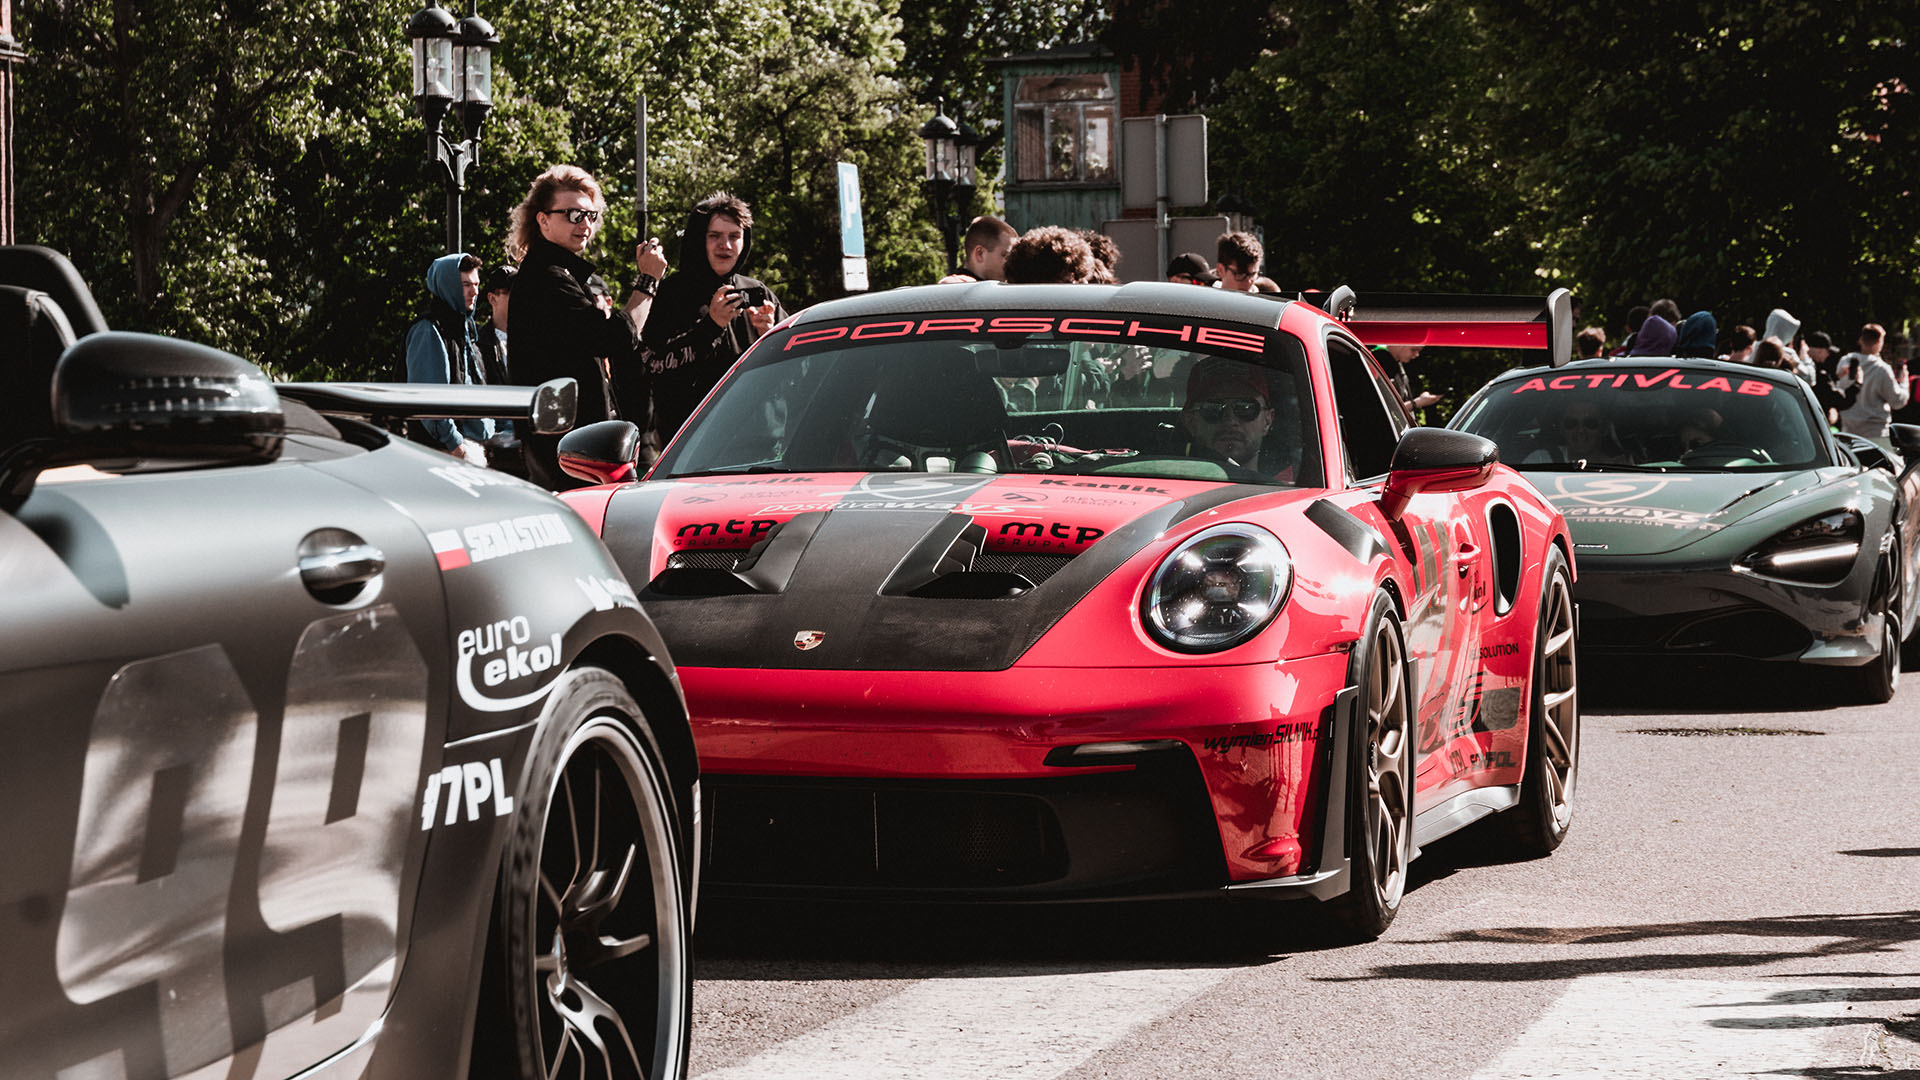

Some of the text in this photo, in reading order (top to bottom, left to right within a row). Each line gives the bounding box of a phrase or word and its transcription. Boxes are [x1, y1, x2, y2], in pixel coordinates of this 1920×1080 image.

[843, 172, 857, 230] P
[783, 316, 1266, 353] PORSCHE
[1512, 368, 1774, 396] ACTIVLAB
[1039, 479, 1171, 494] Karlik
[755, 499, 1042, 517] positiveways
[676, 519, 778, 538] mtp
[999, 521, 1105, 545] mtp
[673, 537, 741, 547] GRUPA
[996, 537, 1067, 549] GRUPA
[458, 615, 531, 657] euro
[483, 633, 562, 687] ekol
[421, 757, 514, 831] #7PL
